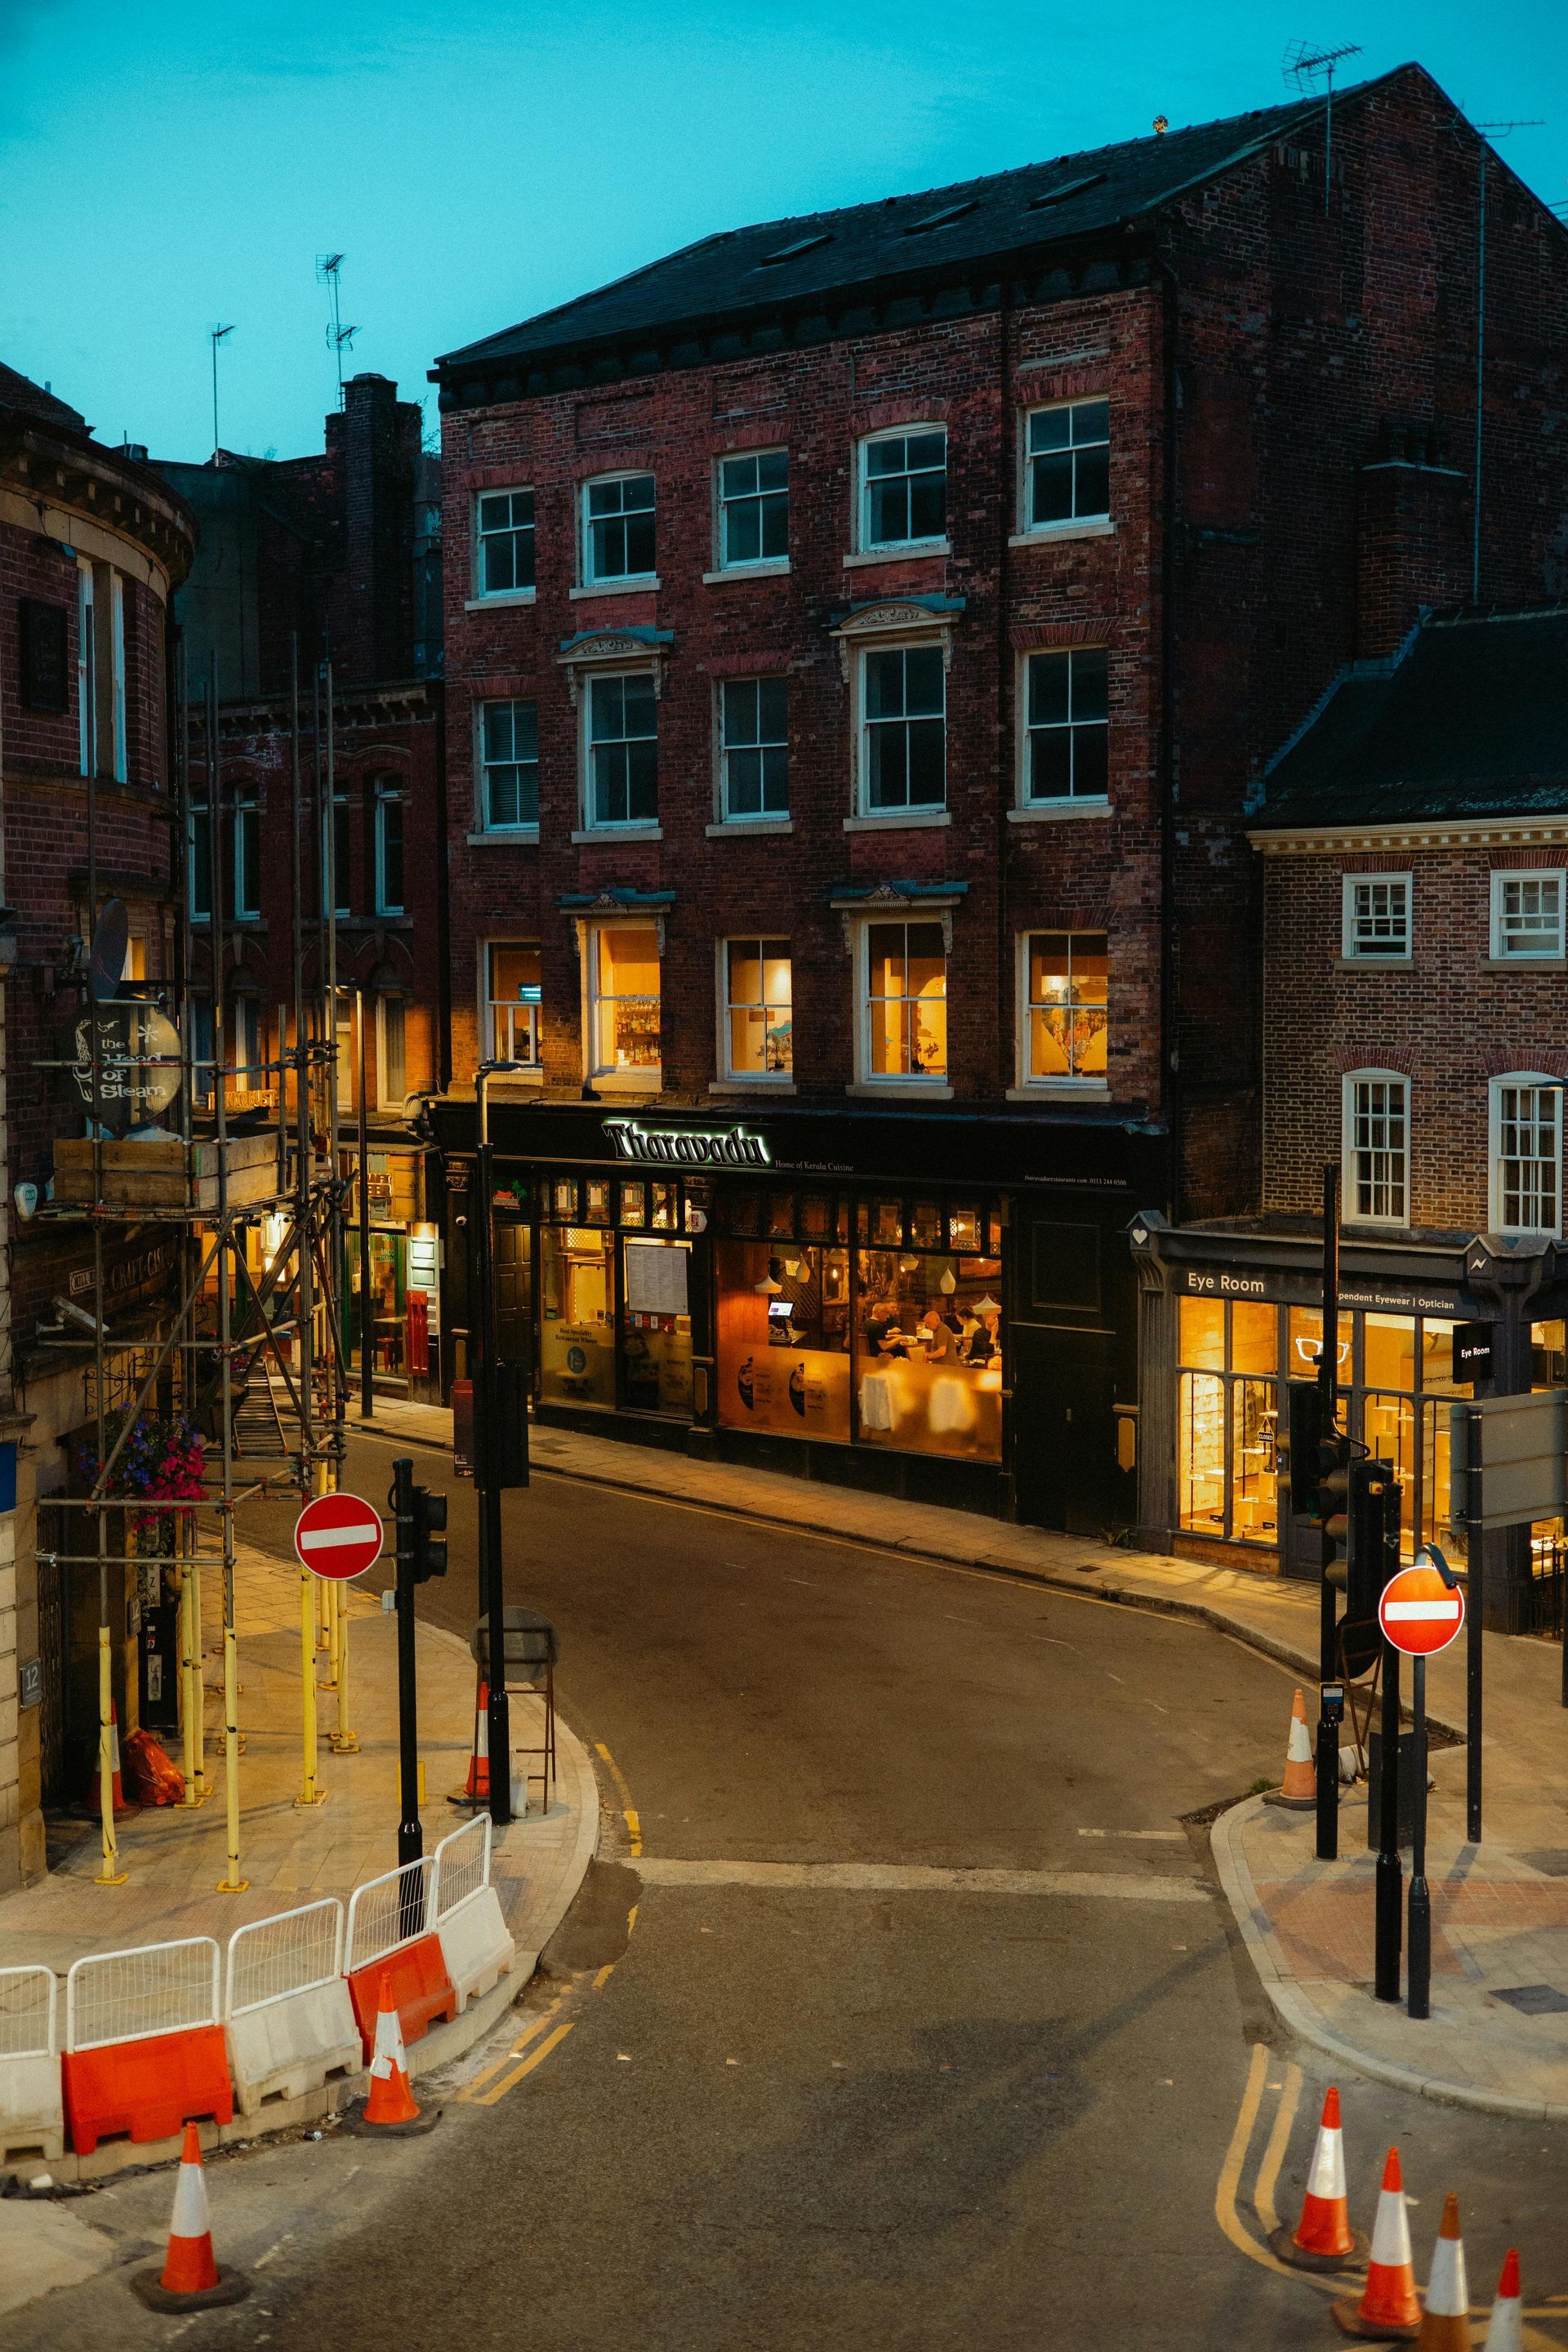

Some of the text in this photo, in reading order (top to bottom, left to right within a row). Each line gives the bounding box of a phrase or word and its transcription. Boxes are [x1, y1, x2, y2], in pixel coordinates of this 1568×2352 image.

[101, 1039, 126, 1049] the
[100, 1085, 166, 1098] Steam
[602, 1121, 769, 1166] Tharavadu
[775, 1160, 854, 1172] Home of Kerala Cuisine
[1024, 1175, 1088, 1183] tharavadurestaurantscom
[1188, 1272, 1264, 1293] Eye Room
[1321, 1290, 1373, 1303] Ipendent
[1375, 1294, 1410, 1307] Eyewear
[1418, 1298, 1454, 1309] Optician
[1461, 1347, 1490, 1359] Eye Room
[26, 1666, 38, 1690] 12
